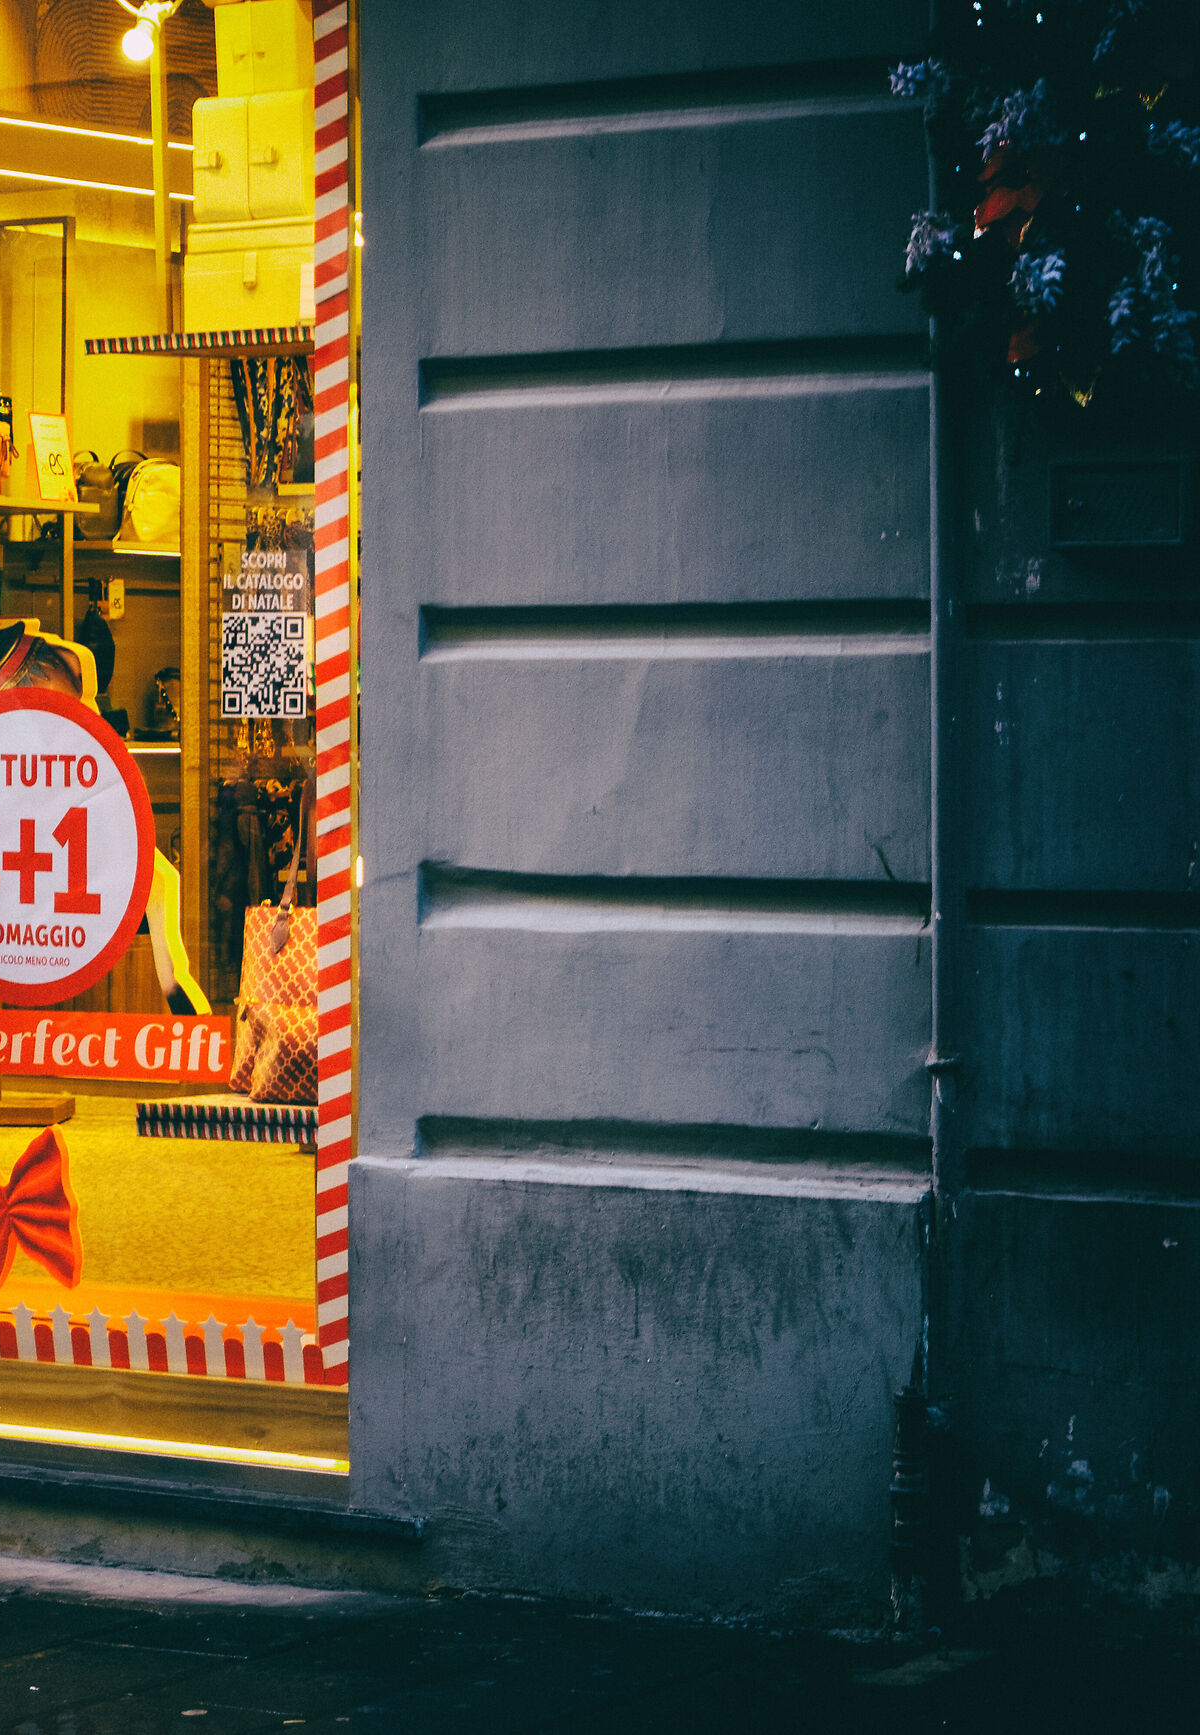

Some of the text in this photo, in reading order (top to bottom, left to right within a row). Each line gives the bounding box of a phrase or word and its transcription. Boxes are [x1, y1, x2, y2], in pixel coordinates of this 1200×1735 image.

[241, 552, 287, 569] SCOPRI
[223, 573, 304, 590] IL CATALOGO
[232, 593, 294, 610] DI NATALE
[0, 754, 99, 788] TUTTO
[25, 956, 48, 967] MENO
[49, 957, 70, 968] CARO
[134, 1022, 227, 1072] Gift
